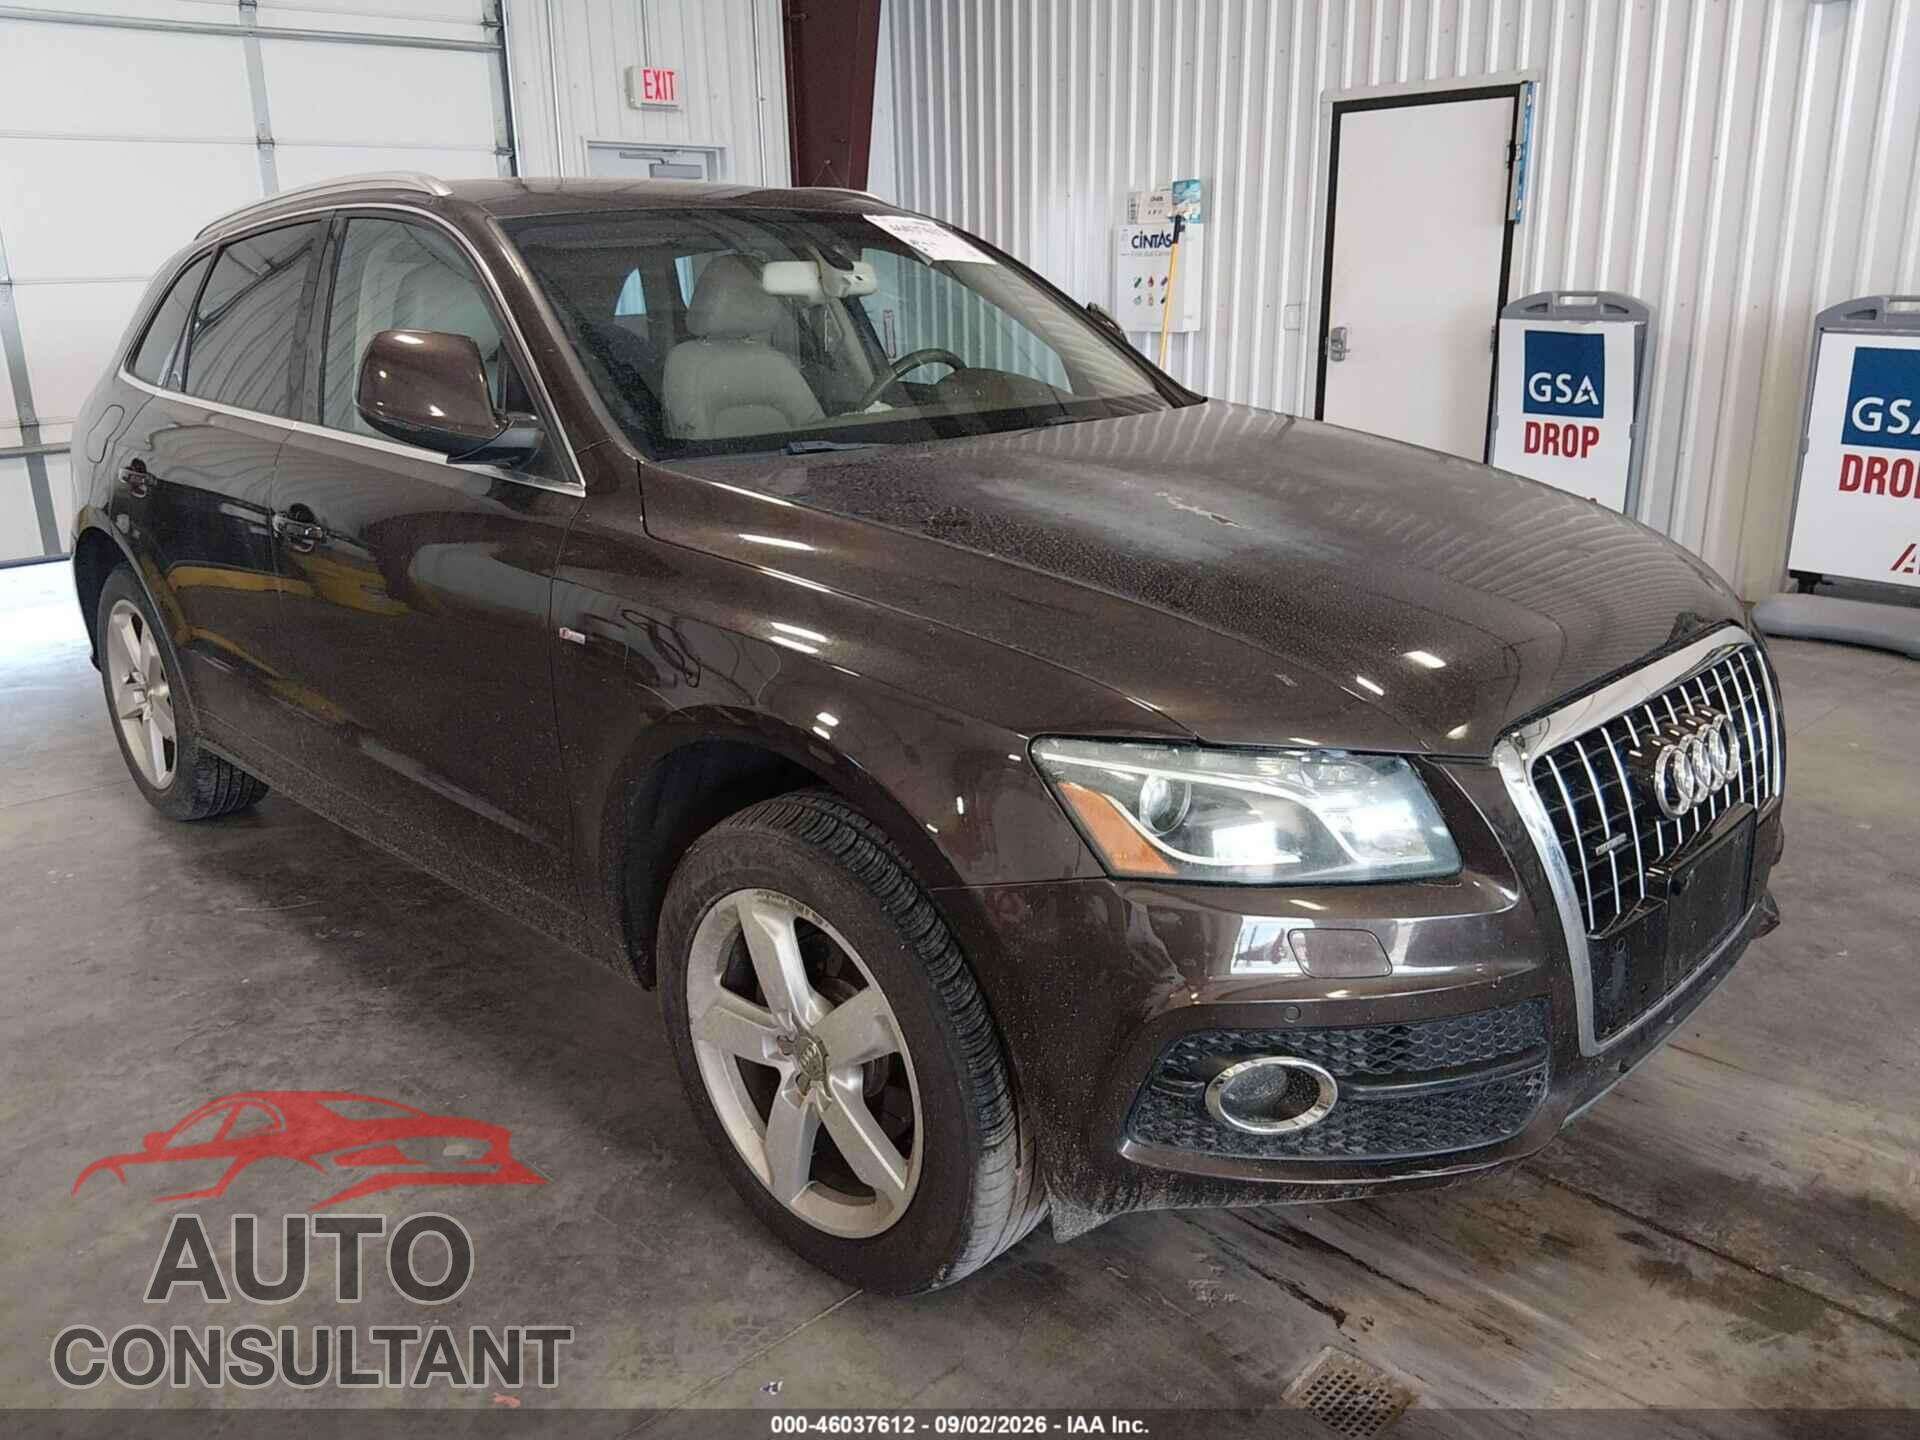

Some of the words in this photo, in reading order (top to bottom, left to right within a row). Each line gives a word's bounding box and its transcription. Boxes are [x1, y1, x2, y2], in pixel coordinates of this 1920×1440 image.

[643, 68, 674, 101] EXIT
[1131, 229, 1172, 249] CINTAS
[1528, 371, 1600, 406] GSA
[1523, 421, 1600, 459] DROP
